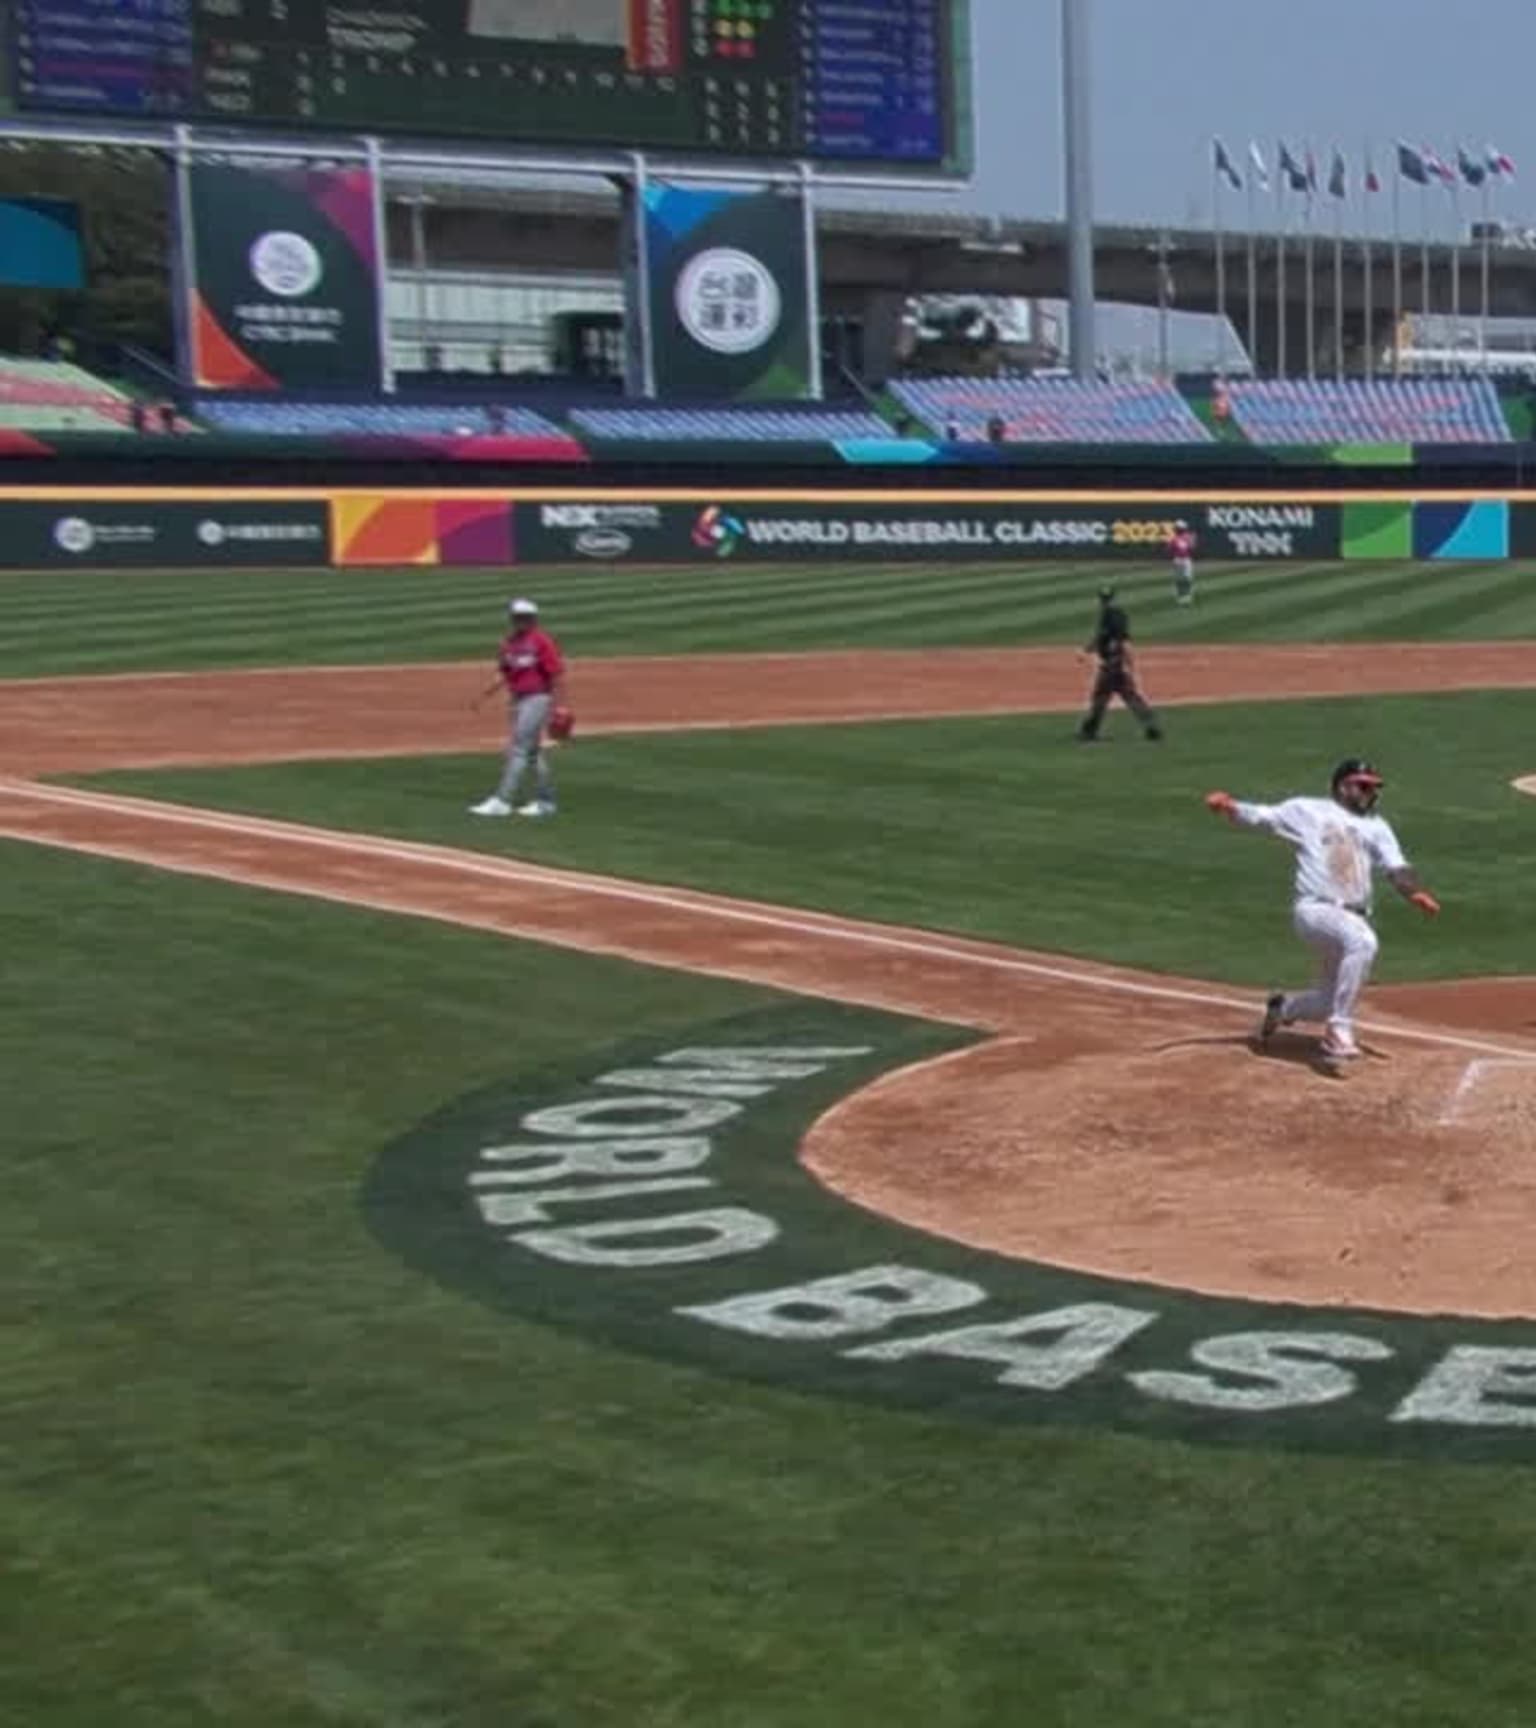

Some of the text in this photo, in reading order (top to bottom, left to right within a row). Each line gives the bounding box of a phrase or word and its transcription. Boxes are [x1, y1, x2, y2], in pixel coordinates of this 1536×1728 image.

[1208, 506, 1313, 528] KONAMI
[748, 520, 1177, 543] WORLD BASEBALL CLASSIC 2023
[467, 1046, 879, 1267] WORLD
